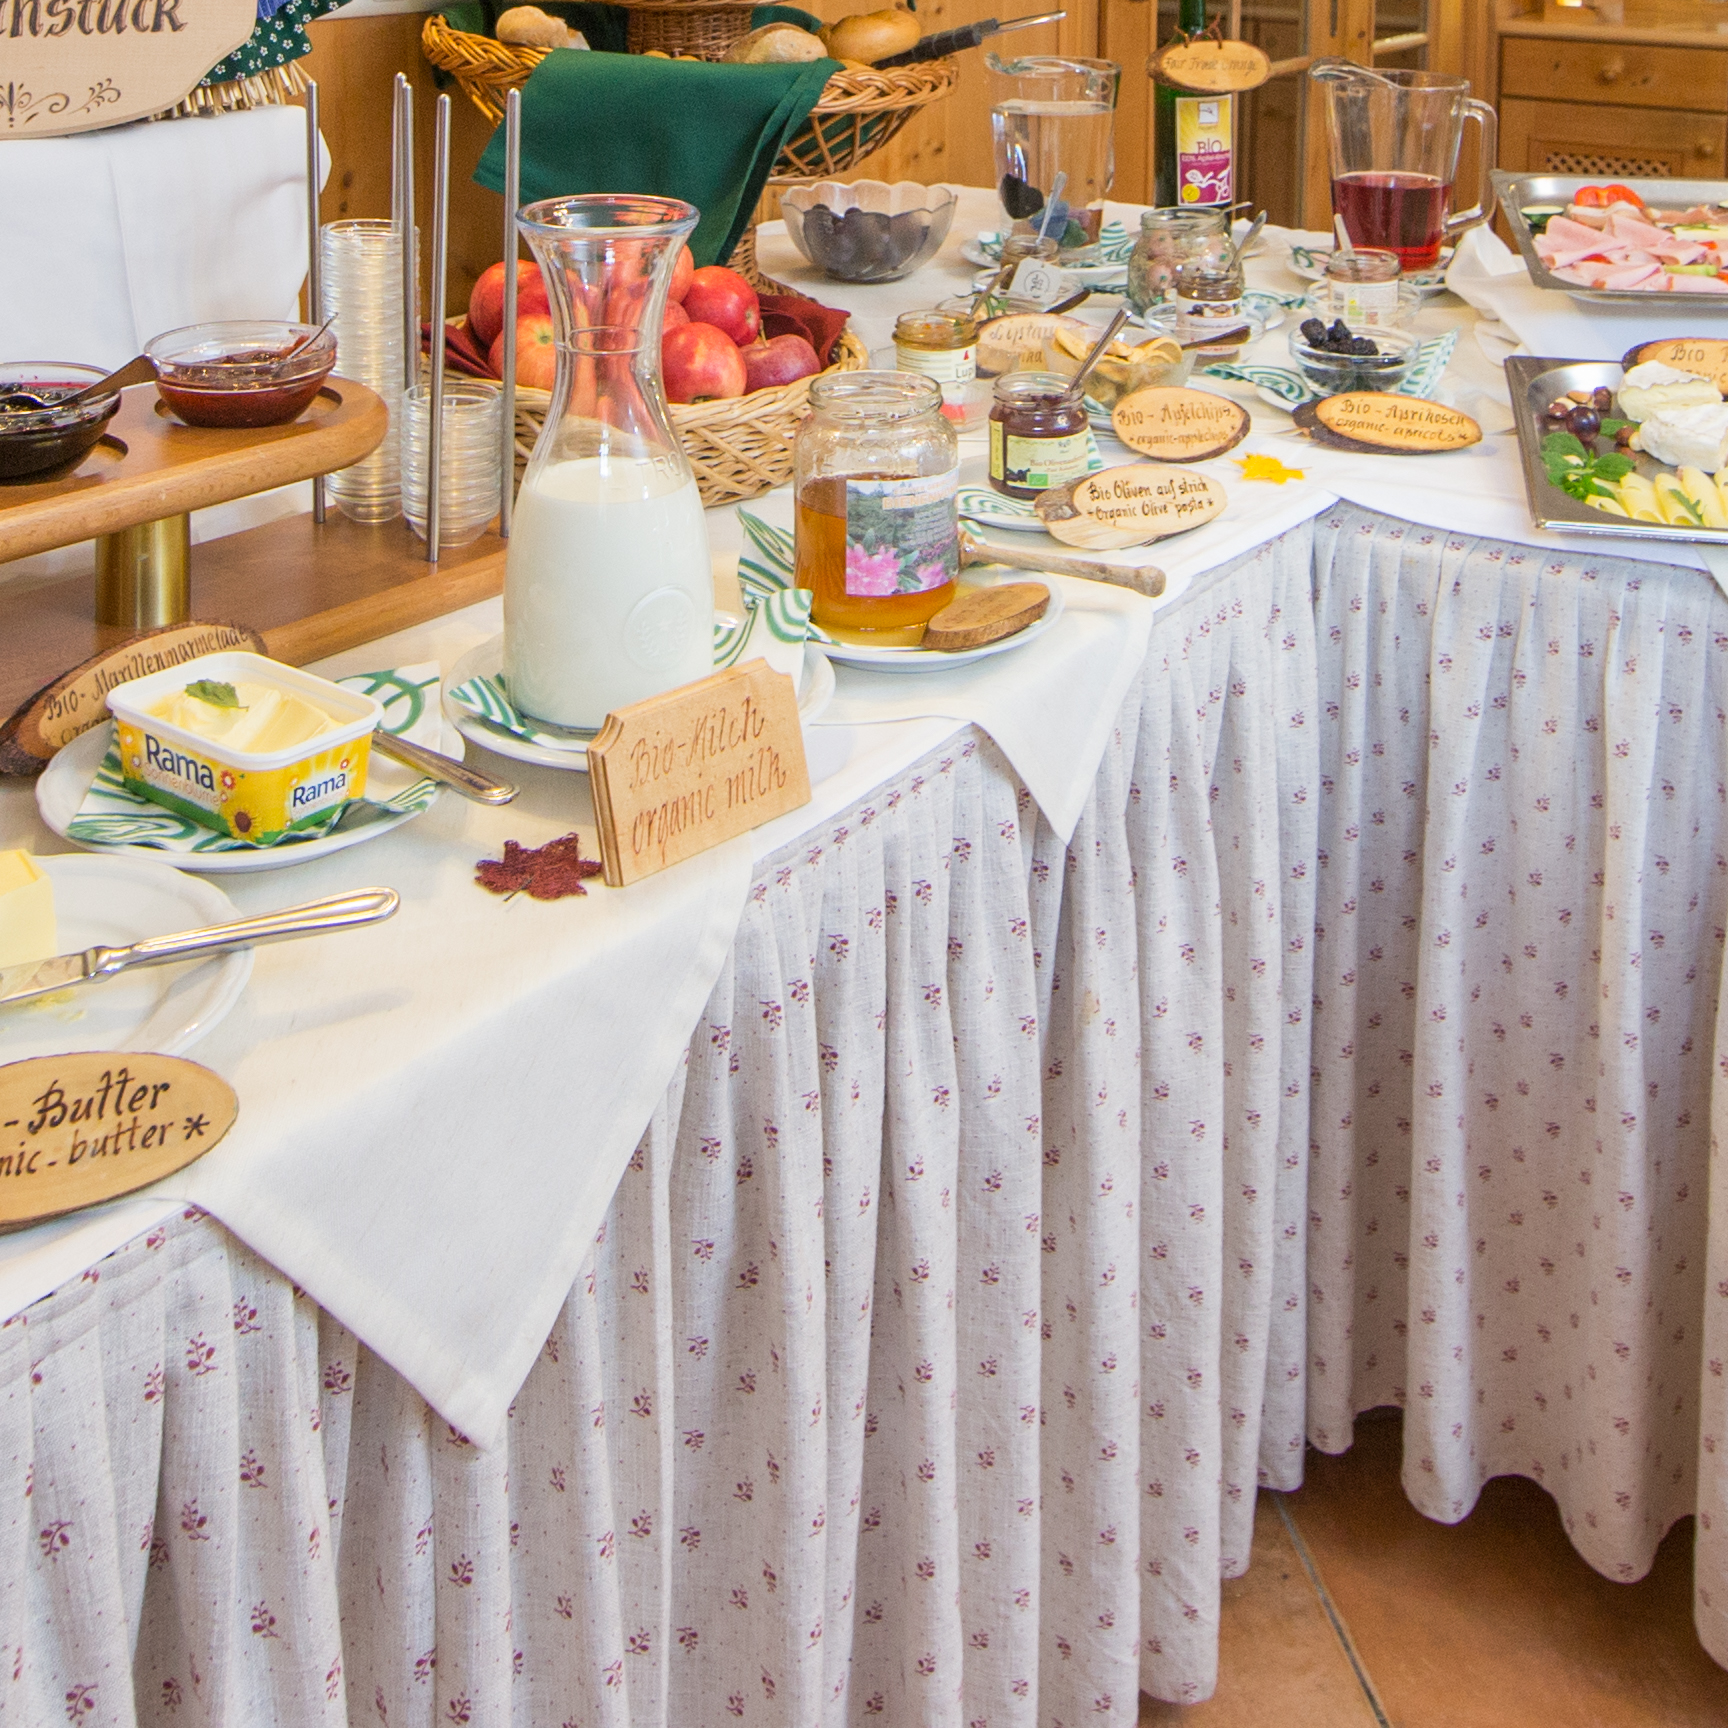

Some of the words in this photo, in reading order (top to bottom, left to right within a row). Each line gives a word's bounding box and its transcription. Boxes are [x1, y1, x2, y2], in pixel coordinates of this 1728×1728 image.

[1197, 138, 1222, 154] BIO
[1670, 341, 1705, 362] Bio
[1340, 398, 1371, 414] Bio
[1087, 481, 1112, 502] Bio
[1113, 479, 1152, 500] Oliven
[145, 733, 215, 792] Rama
[292, 772, 347, 808] Rama
[632, 773, 715, 865] organic
[725, 745, 787, 810] milk
[27, 1066, 172, 1135] Butter
